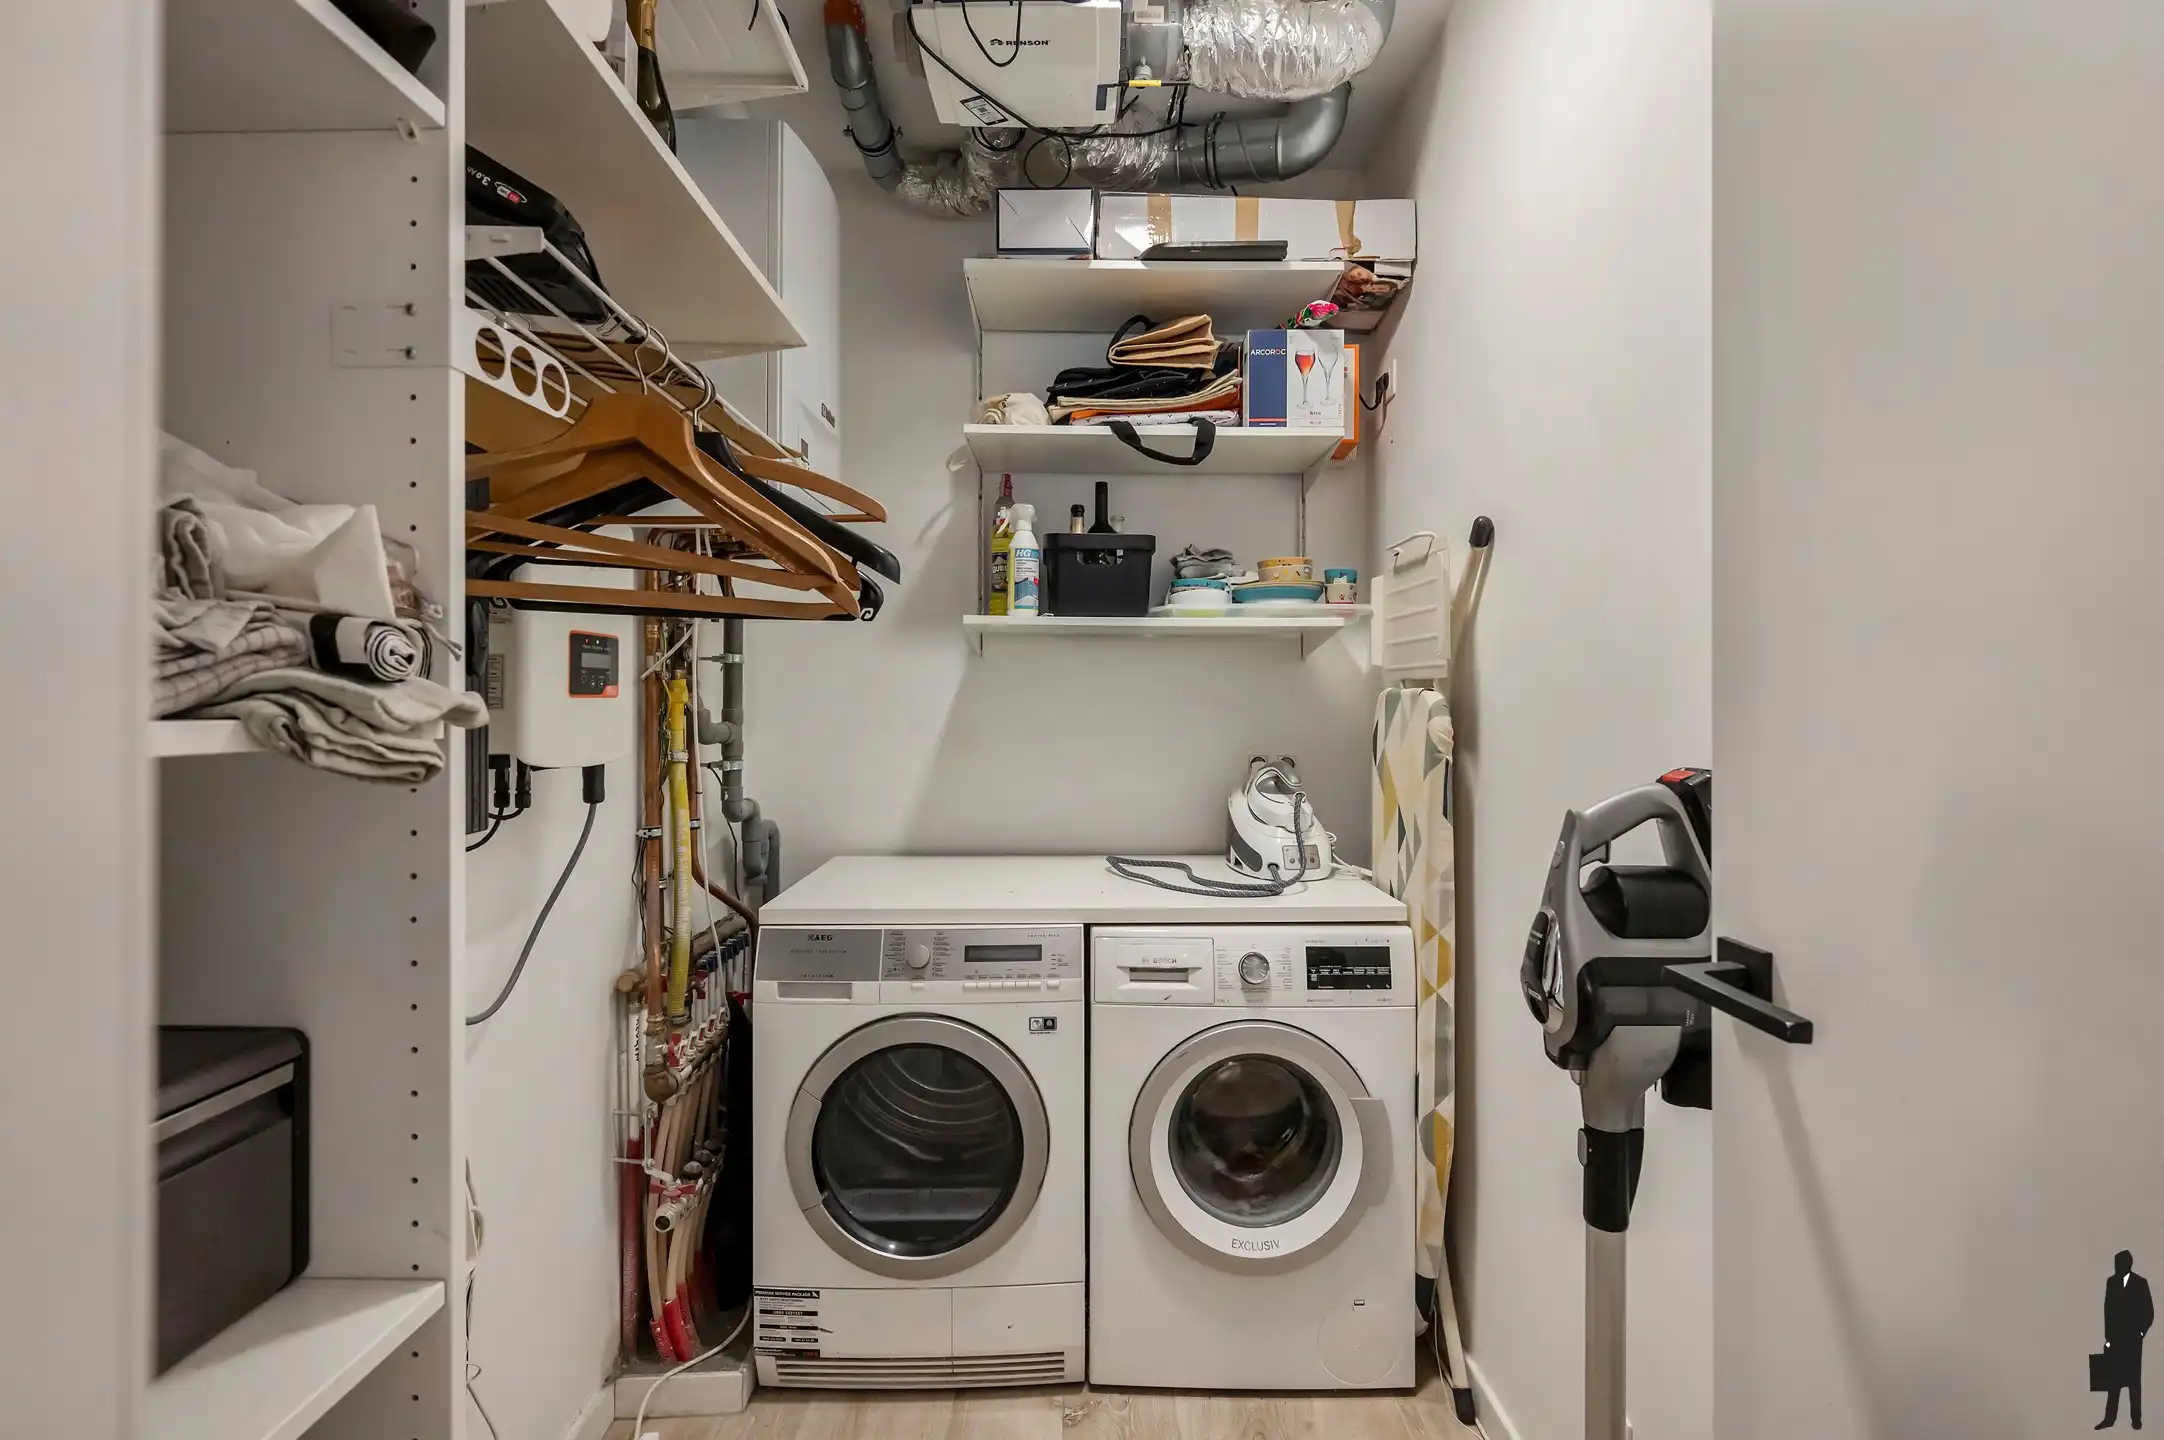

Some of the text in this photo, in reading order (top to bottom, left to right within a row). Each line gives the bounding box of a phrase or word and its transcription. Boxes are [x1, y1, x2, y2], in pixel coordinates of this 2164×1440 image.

[1250, 348, 1286, 356] ARCOROC
[1016, 549, 1032, 557] HG
[1231, 1238, 1280, 1251] EXCLUSIV
